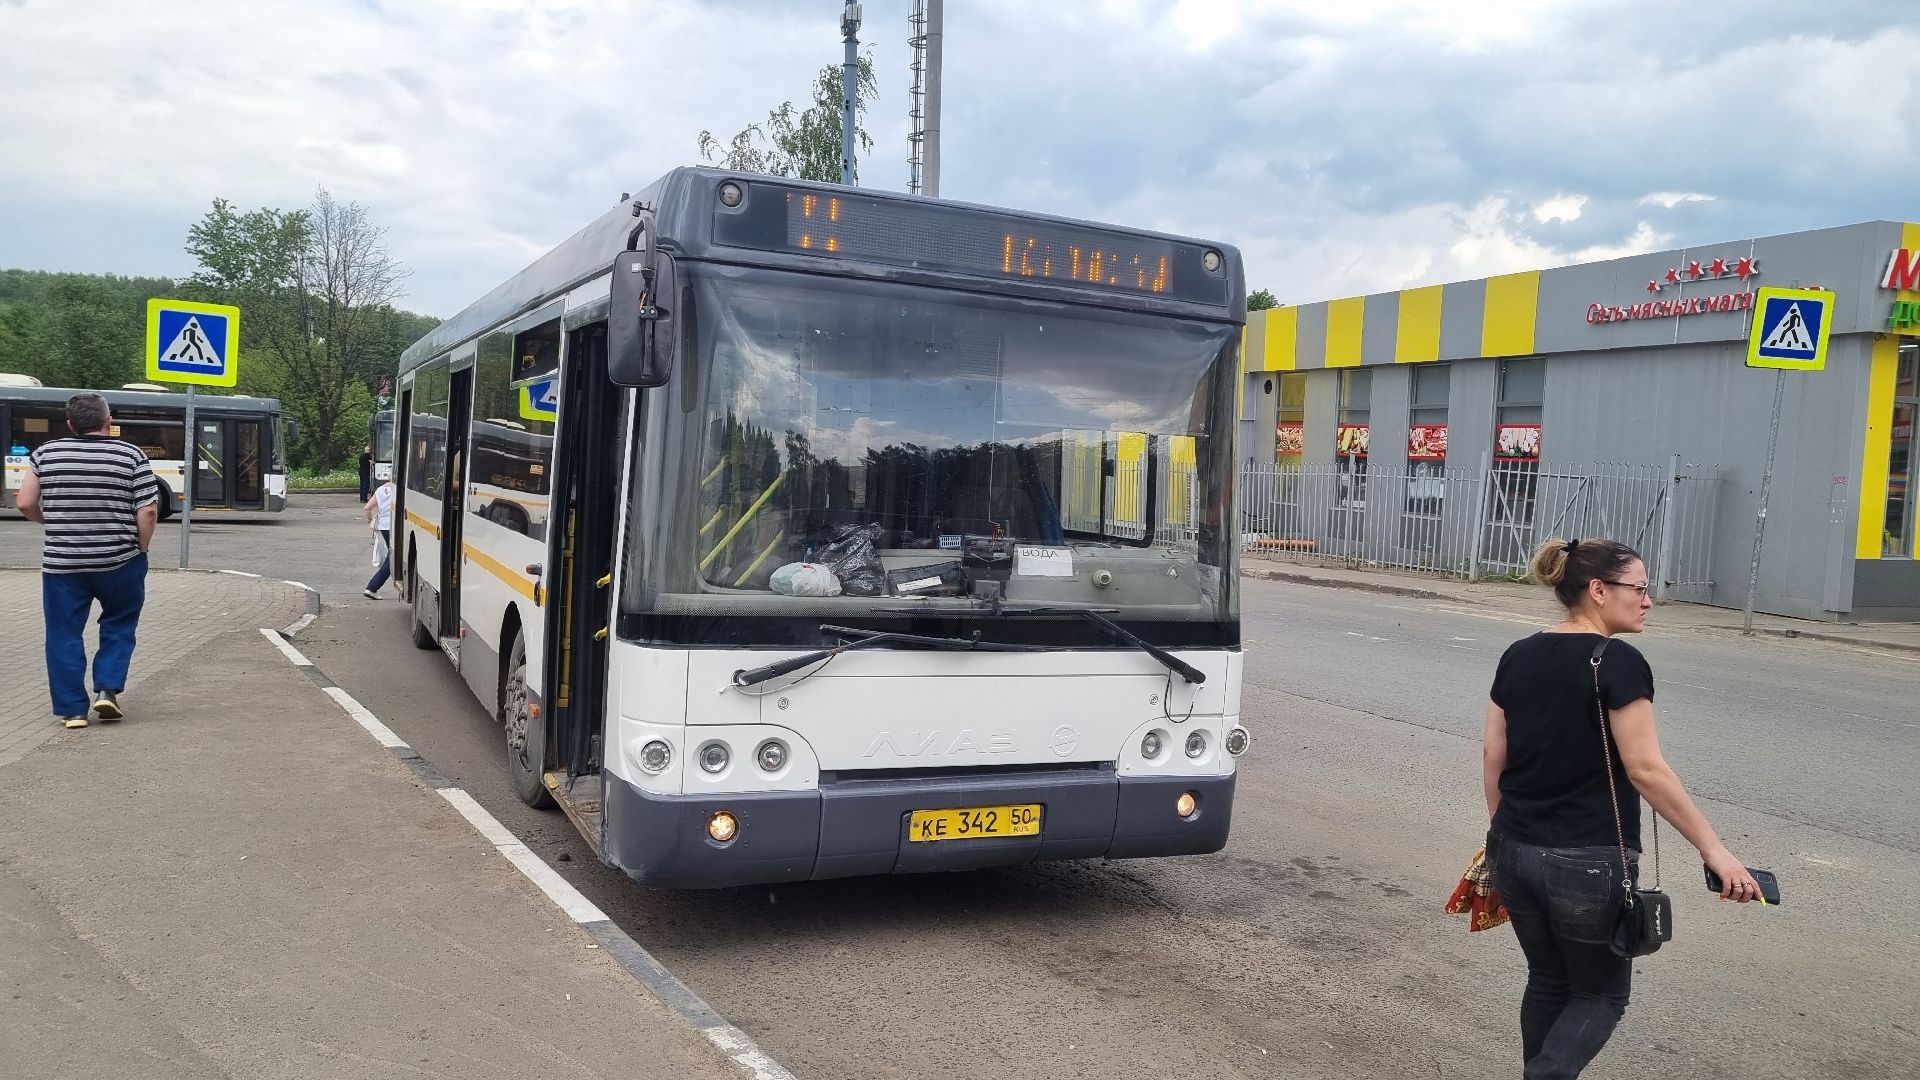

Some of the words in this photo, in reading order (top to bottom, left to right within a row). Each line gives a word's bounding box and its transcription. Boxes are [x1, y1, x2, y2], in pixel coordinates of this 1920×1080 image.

[1880, 248, 1920, 291] М
[1586, 303, 1628, 324] Сеть
[1629, 297, 1701, 320] мясных
[1705, 292, 1756, 312] мага
[958, 810, 998, 834] 342
[1010, 808, 1031, 825] 50
[1013, 825, 1029, 833] RUS
